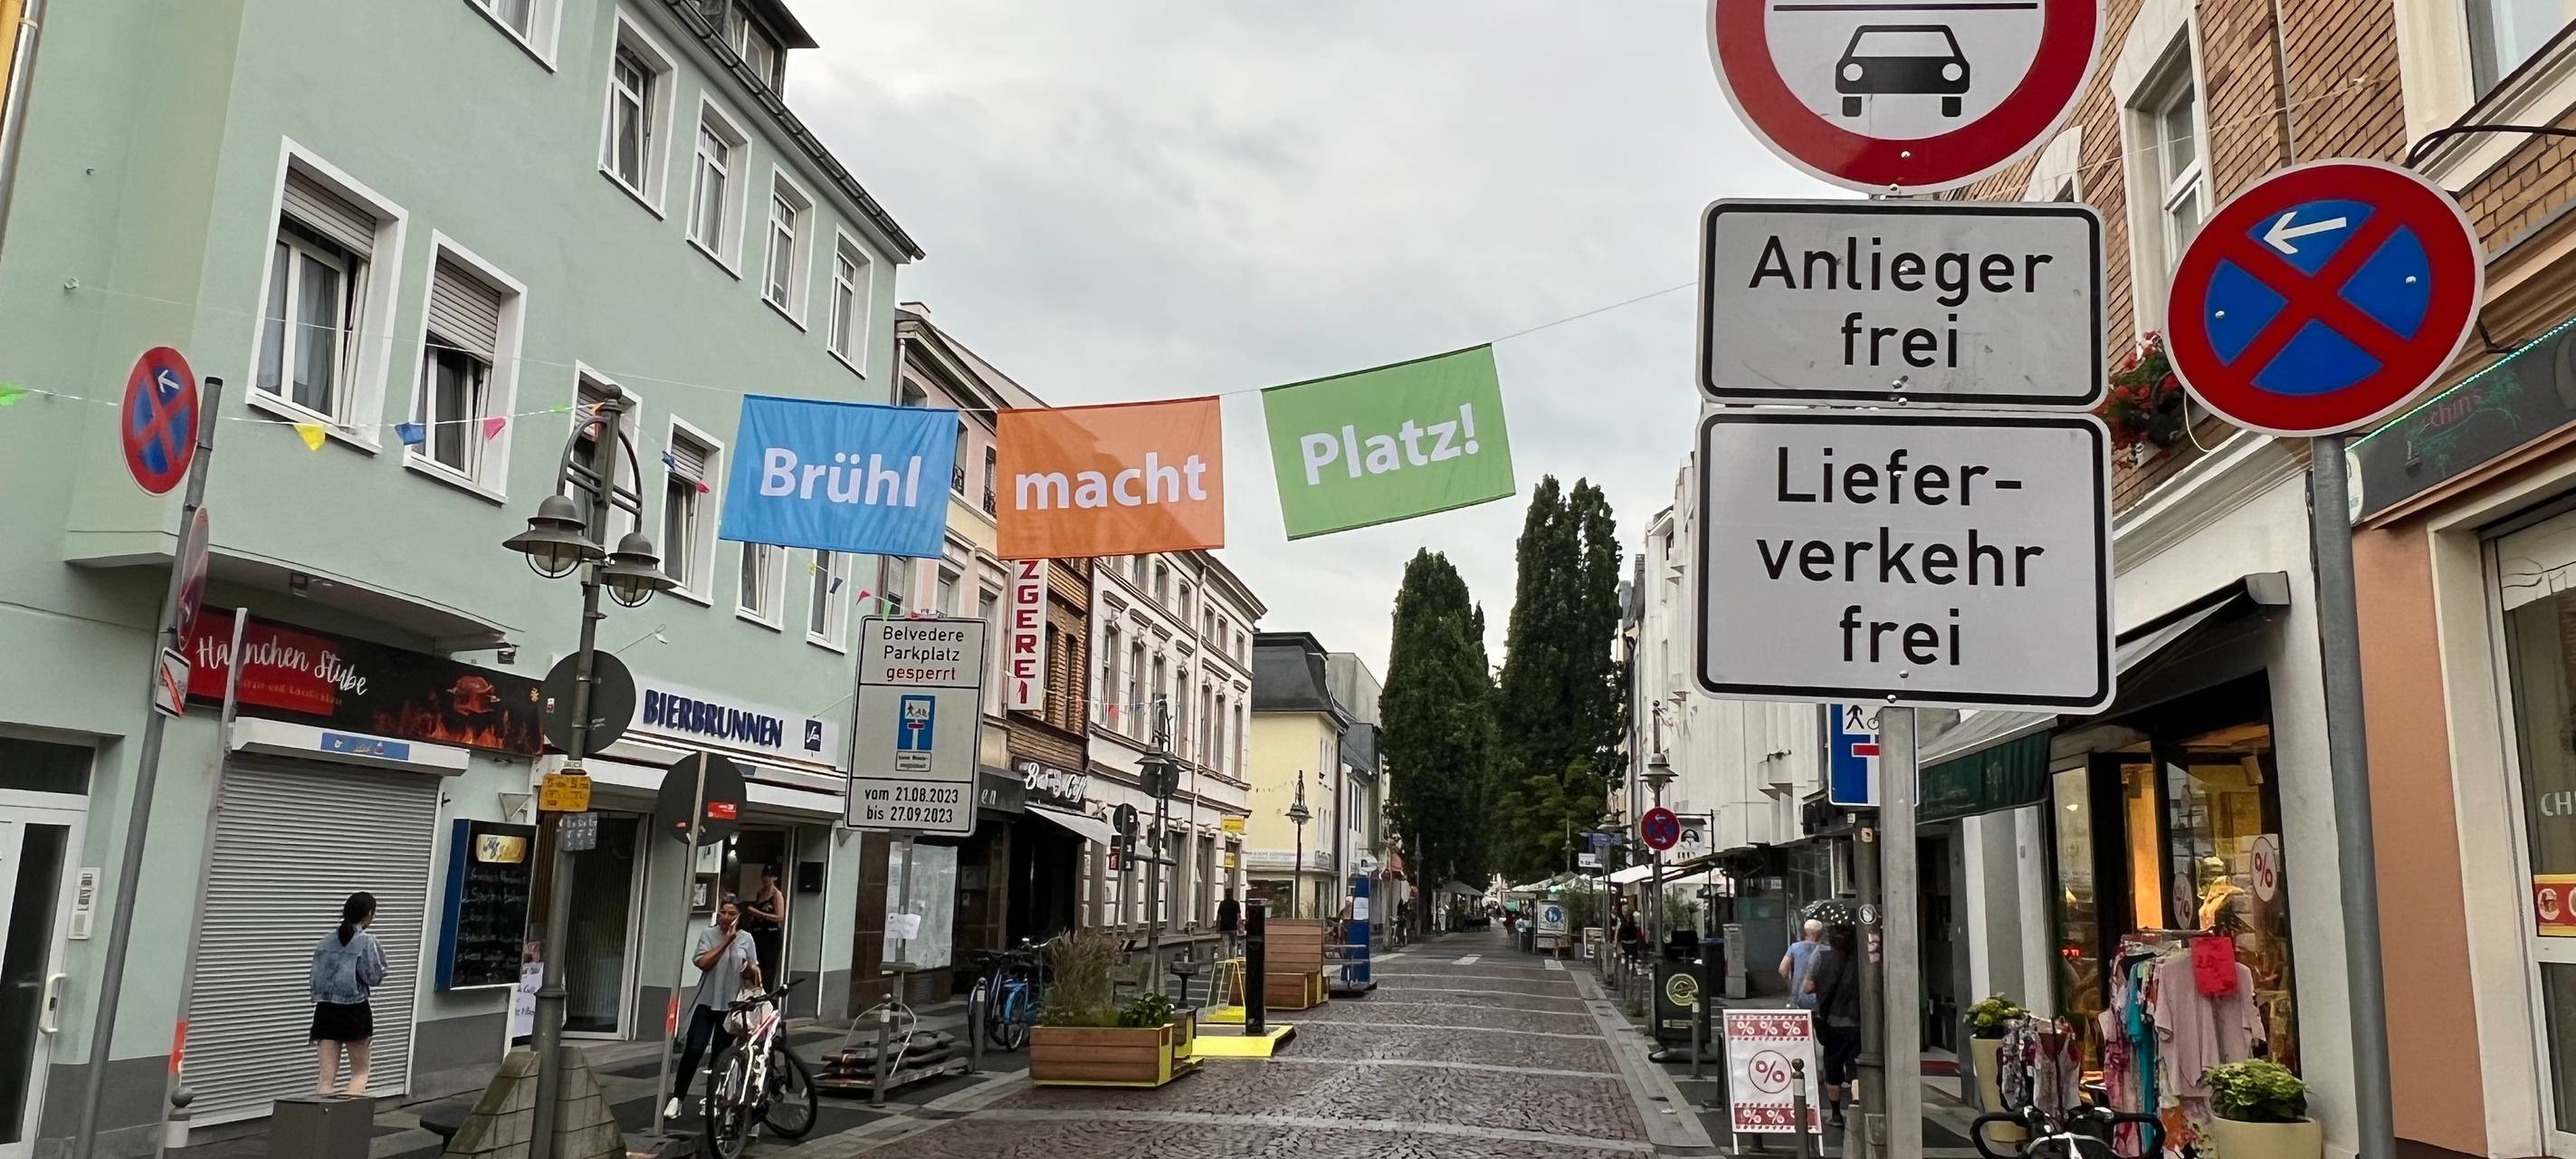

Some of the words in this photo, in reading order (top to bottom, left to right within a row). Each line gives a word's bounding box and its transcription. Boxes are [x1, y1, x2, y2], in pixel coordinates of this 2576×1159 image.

[1749, 235, 2053, 307] Anlieger
[1842, 312, 1957, 368] frei
[759, 446, 921, 509] Brühl
[1016, 452, 1207, 511] macht
[1301, 402, 1480, 486] Platz!
[1779, 447, 2021, 505] Liefer-
[1757, 527, 2044, 587] verkehr
[883, 626, 964, 642] Belvedere
[884, 646, 959, 664] Parkplatz
[1013, 560, 1041, 704] ZGEREI
[1840, 606, 1959, 666] frei
[196, 636, 310, 672] Hänchen
[314, 650, 367, 695] Stube
[886, 666, 956, 683] gesperrt
[644, 689, 784, 750] BIERBRUNNEN
[864, 789, 890, 802] vom
[895, 786, 959, 804] 21.08.2023
[866, 805, 885, 821] bis
[891, 806, 953, 824] 27.09.2023
[981, 790, 997, 806] en
[2541, 790, 2576, 817] CH
